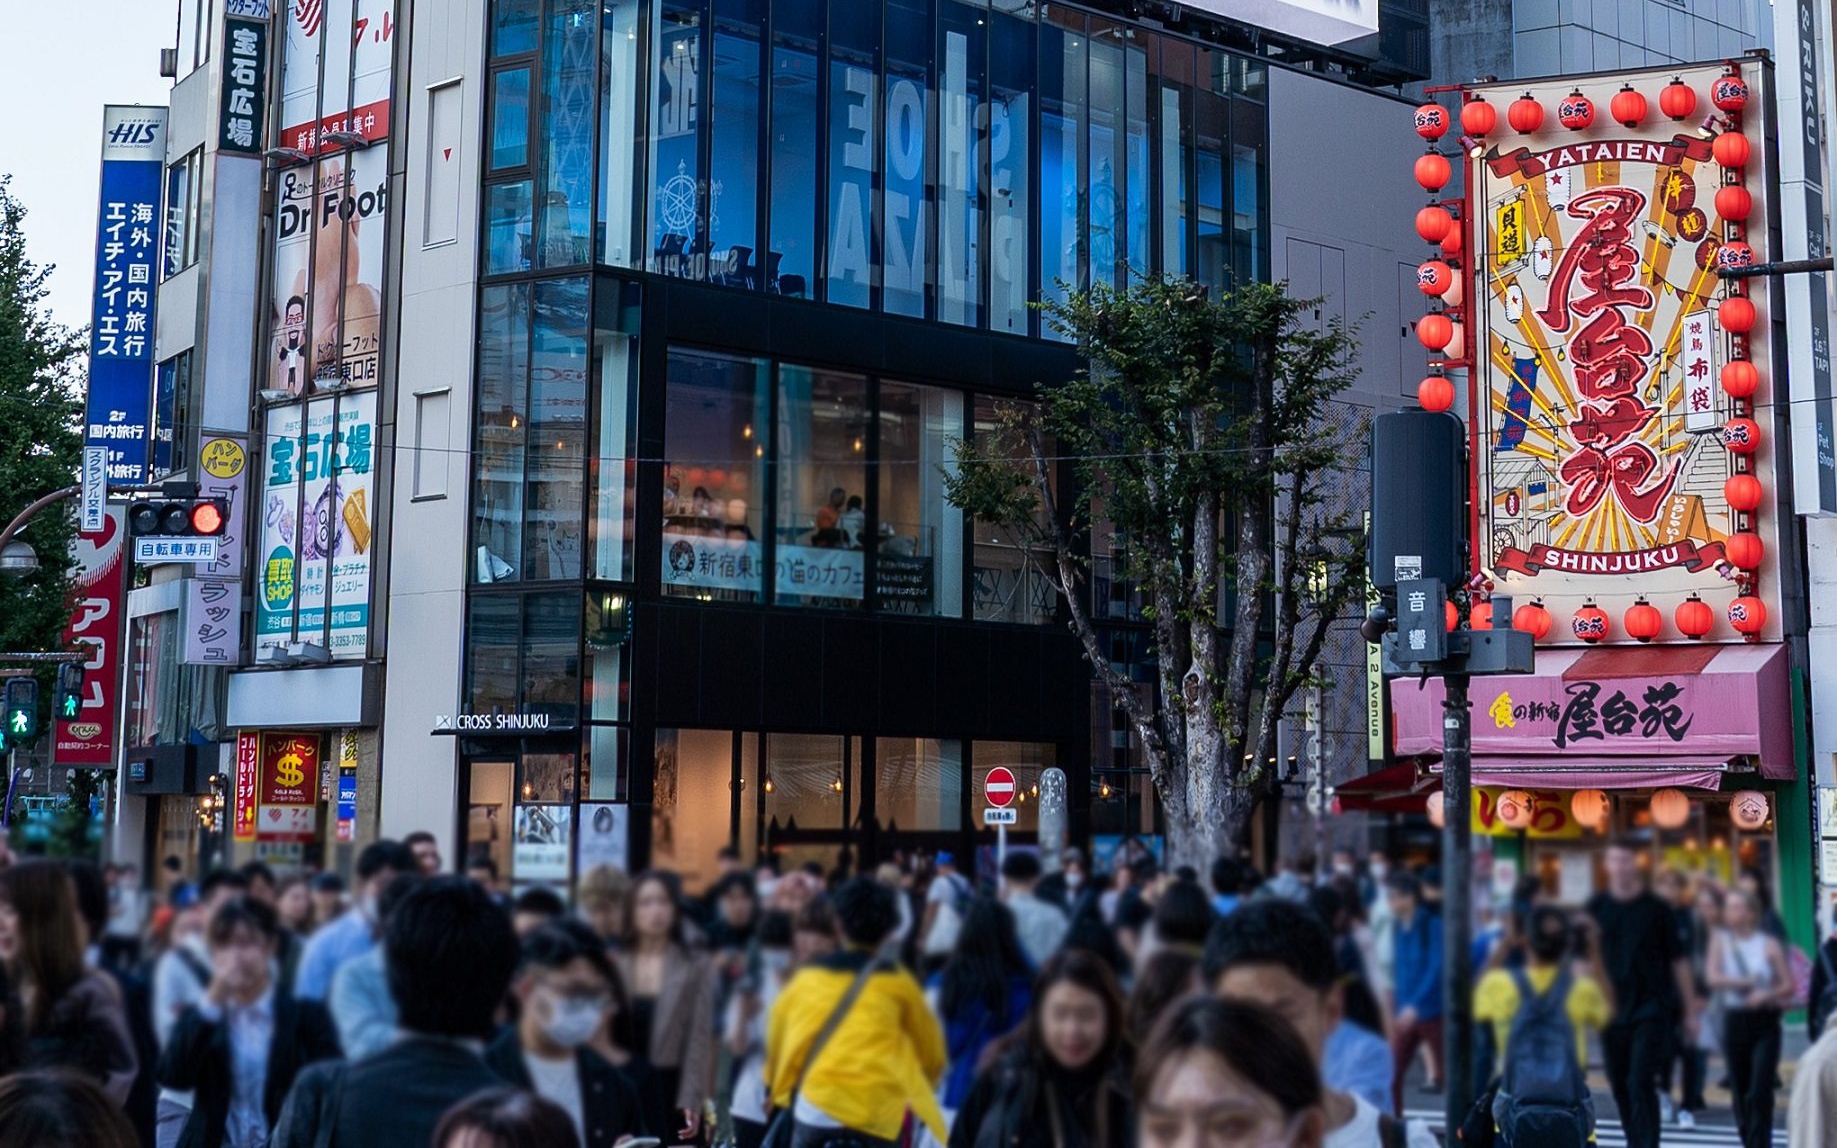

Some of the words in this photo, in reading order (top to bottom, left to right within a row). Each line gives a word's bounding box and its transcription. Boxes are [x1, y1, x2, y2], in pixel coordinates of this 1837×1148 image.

[1801, 4, 1811, 33] &
[226, 28, 258, 148] 宝石広場
[1802, 39, 1816, 146] RIKU
[1414, 109, 1442, 127] 台苑
[108, 123, 160, 144] HIS
[1536, 142, 1666, 170] YATAIEN
[279, 204, 311, 240] Dr
[322, 181, 387, 229] Foot
[98, 202, 127, 356] エイチ・アイ・エス
[123, 203, 153, 358] 海外・国内旅行
[316, 333, 378, 362] ドクーフット
[1535, 185, 1684, 524] 屋台苑
[1686, 357, 1711, 414] 布袋
[109, 410, 127, 422] 2F
[89, 424, 145, 440] 国内旅行
[213, 442, 238, 457] ハン
[269, 423, 372, 487] 宝石広場
[106, 464, 142, 479] 外旅行
[205, 456, 242, 473] バーグ
[141, 543, 213, 557] 自転車専用
[1544, 546, 1681, 572] SHINJUKU
[198, 485, 239, 662] ゴドラッシュ
[266, 583, 294, 602] SHOP
[300, 583, 325, 597] ダイヤモン
[1408, 590, 1427, 650] 音響
[1369, 645, 1379, 656] A
[1370, 663, 1379, 673] 2
[457, 714, 492, 729] CROSS
[496, 713, 550, 729] SHINJUKU
[1553, 681, 1695, 749] 屋台苑
[268, 739, 315, 757] ハンバーグ
[246, 738, 257, 798] ハンバーグ
